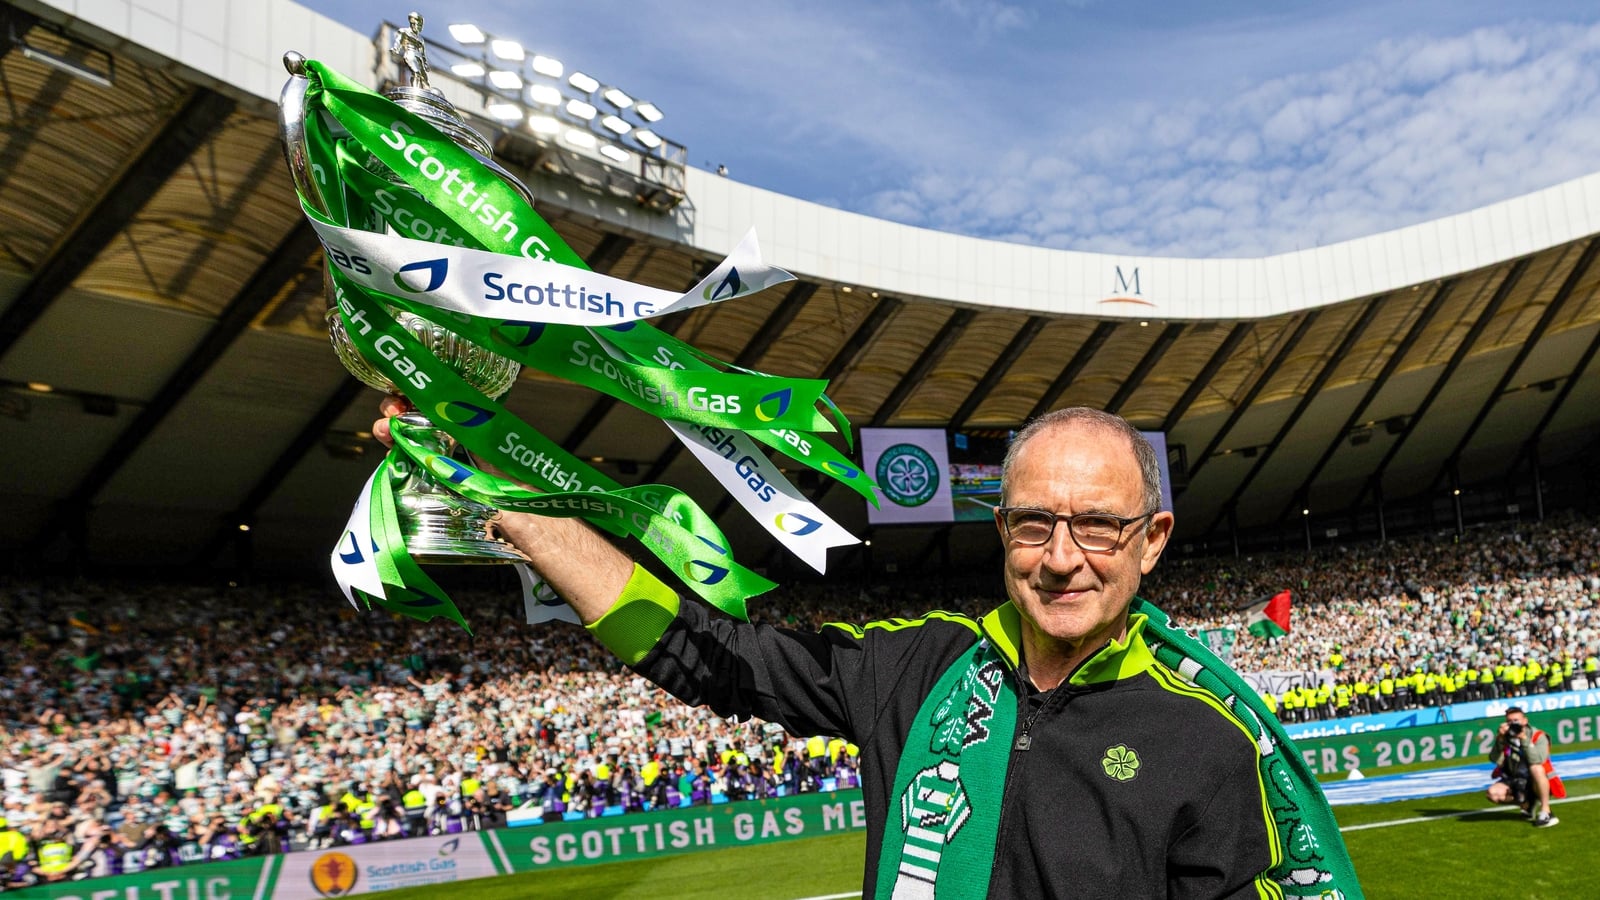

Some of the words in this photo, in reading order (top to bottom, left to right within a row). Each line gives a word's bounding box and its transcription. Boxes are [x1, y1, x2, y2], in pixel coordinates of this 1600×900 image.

[380, 121, 519, 243] Scottish
[519, 235, 558, 263] G
[483, 272, 625, 318] Scottish
[633, 301, 661, 317] G
[1112, 265, 1143, 295] M
[374, 334, 432, 390] Gas
[568, 340, 680, 409] Scottish
[687, 386, 742, 414] Gas
[498, 431, 583, 493] Scottish
[735, 455, 777, 503] Gas
[493, 497, 625, 519] Scottish
[1302, 745, 1360, 775] ERS
[1376, 728, 1495, 767] 2025/2
[530, 817, 716, 866] SCOTTISH
[734, 806, 805, 841] GAS
[366, 860, 427, 878] Scottish
[429, 857, 457, 871] Gas
